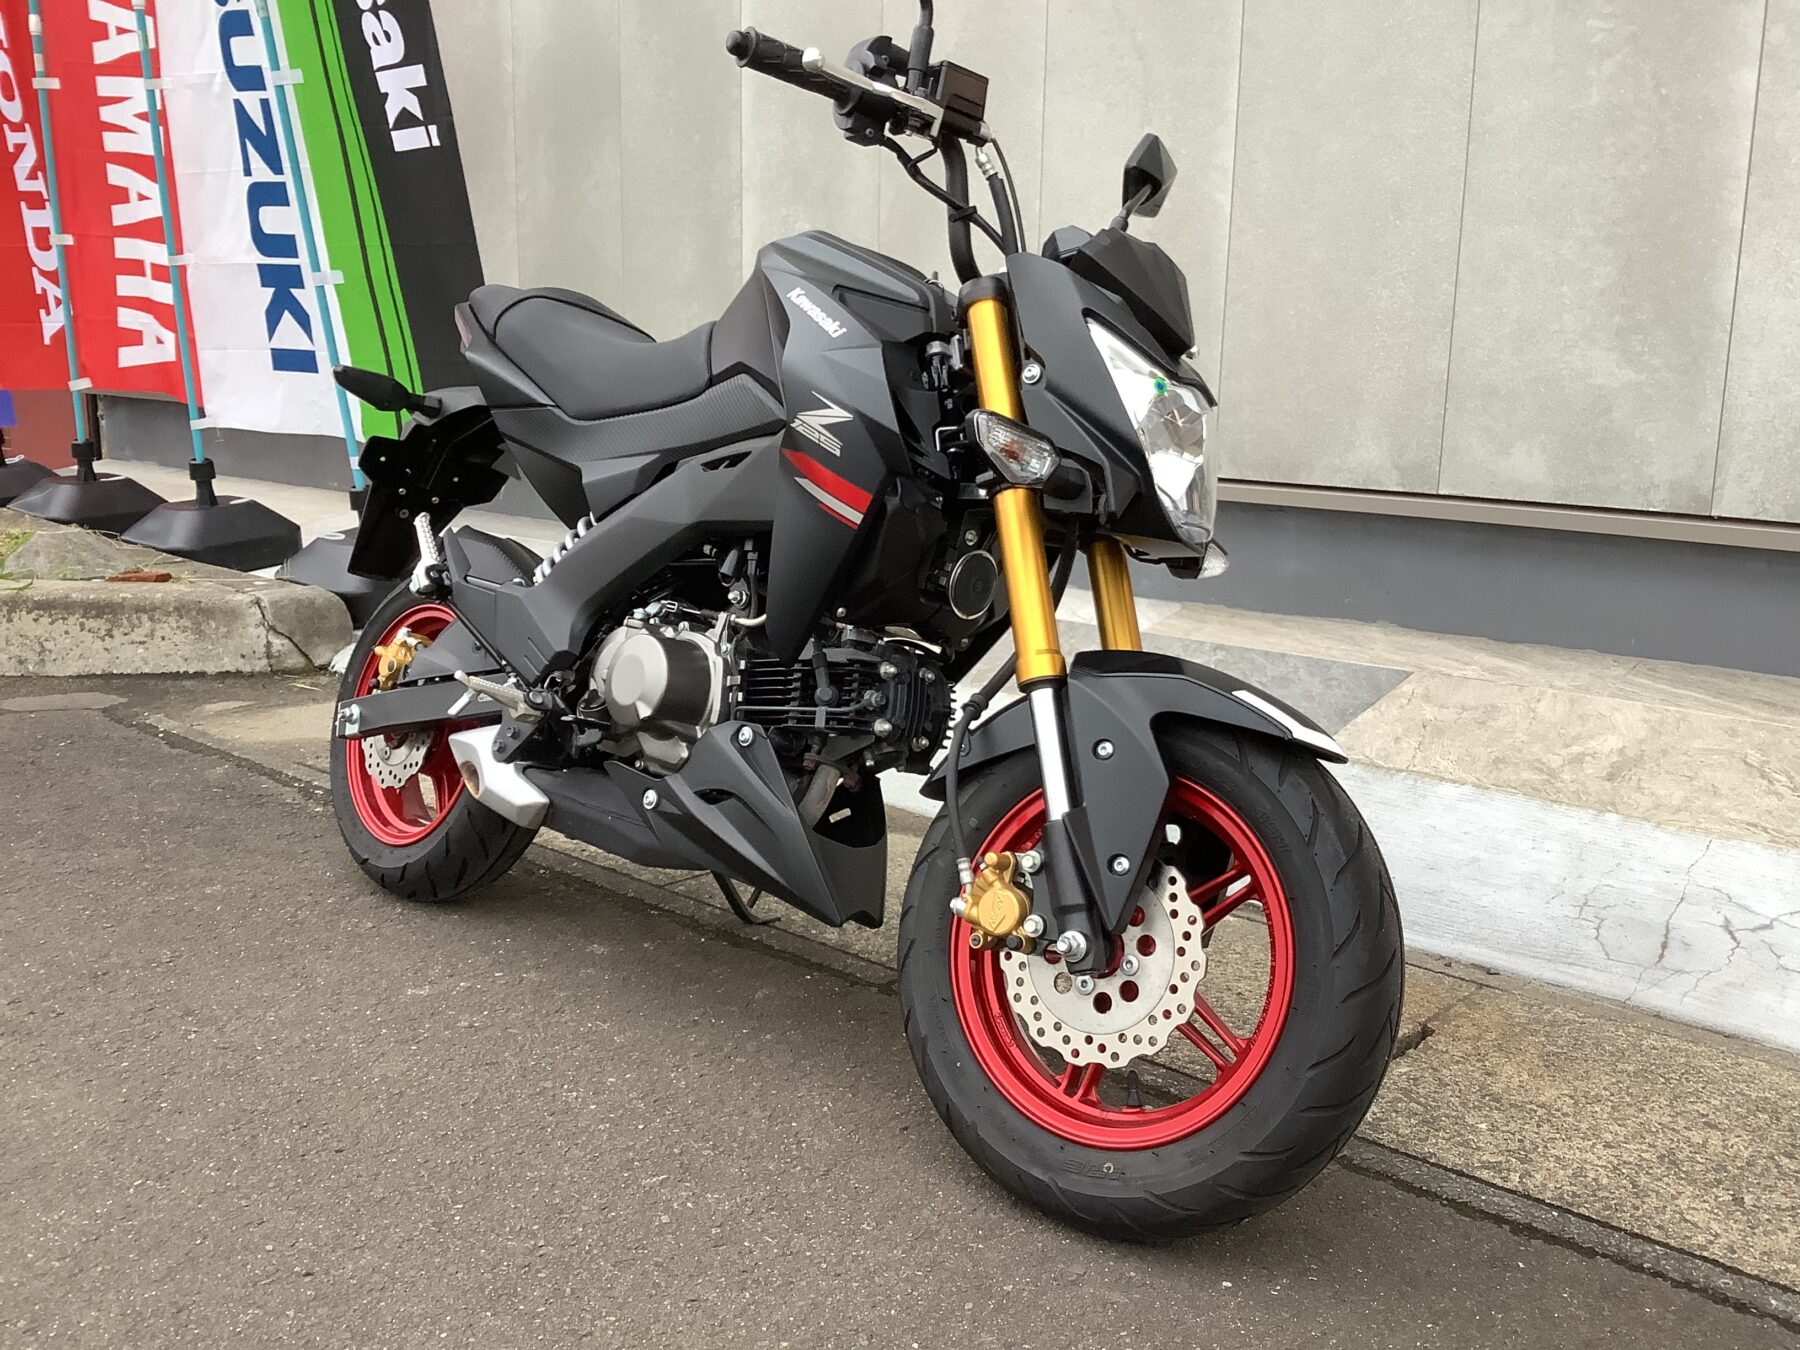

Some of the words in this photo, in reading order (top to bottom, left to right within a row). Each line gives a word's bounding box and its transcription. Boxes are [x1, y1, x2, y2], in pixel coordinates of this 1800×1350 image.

[0, 10, 73, 345] ONDA
[214, 0, 319, 374] UZUKI
[356, 0, 441, 152] aki
[786, 287, 847, 338] Kawasaki
